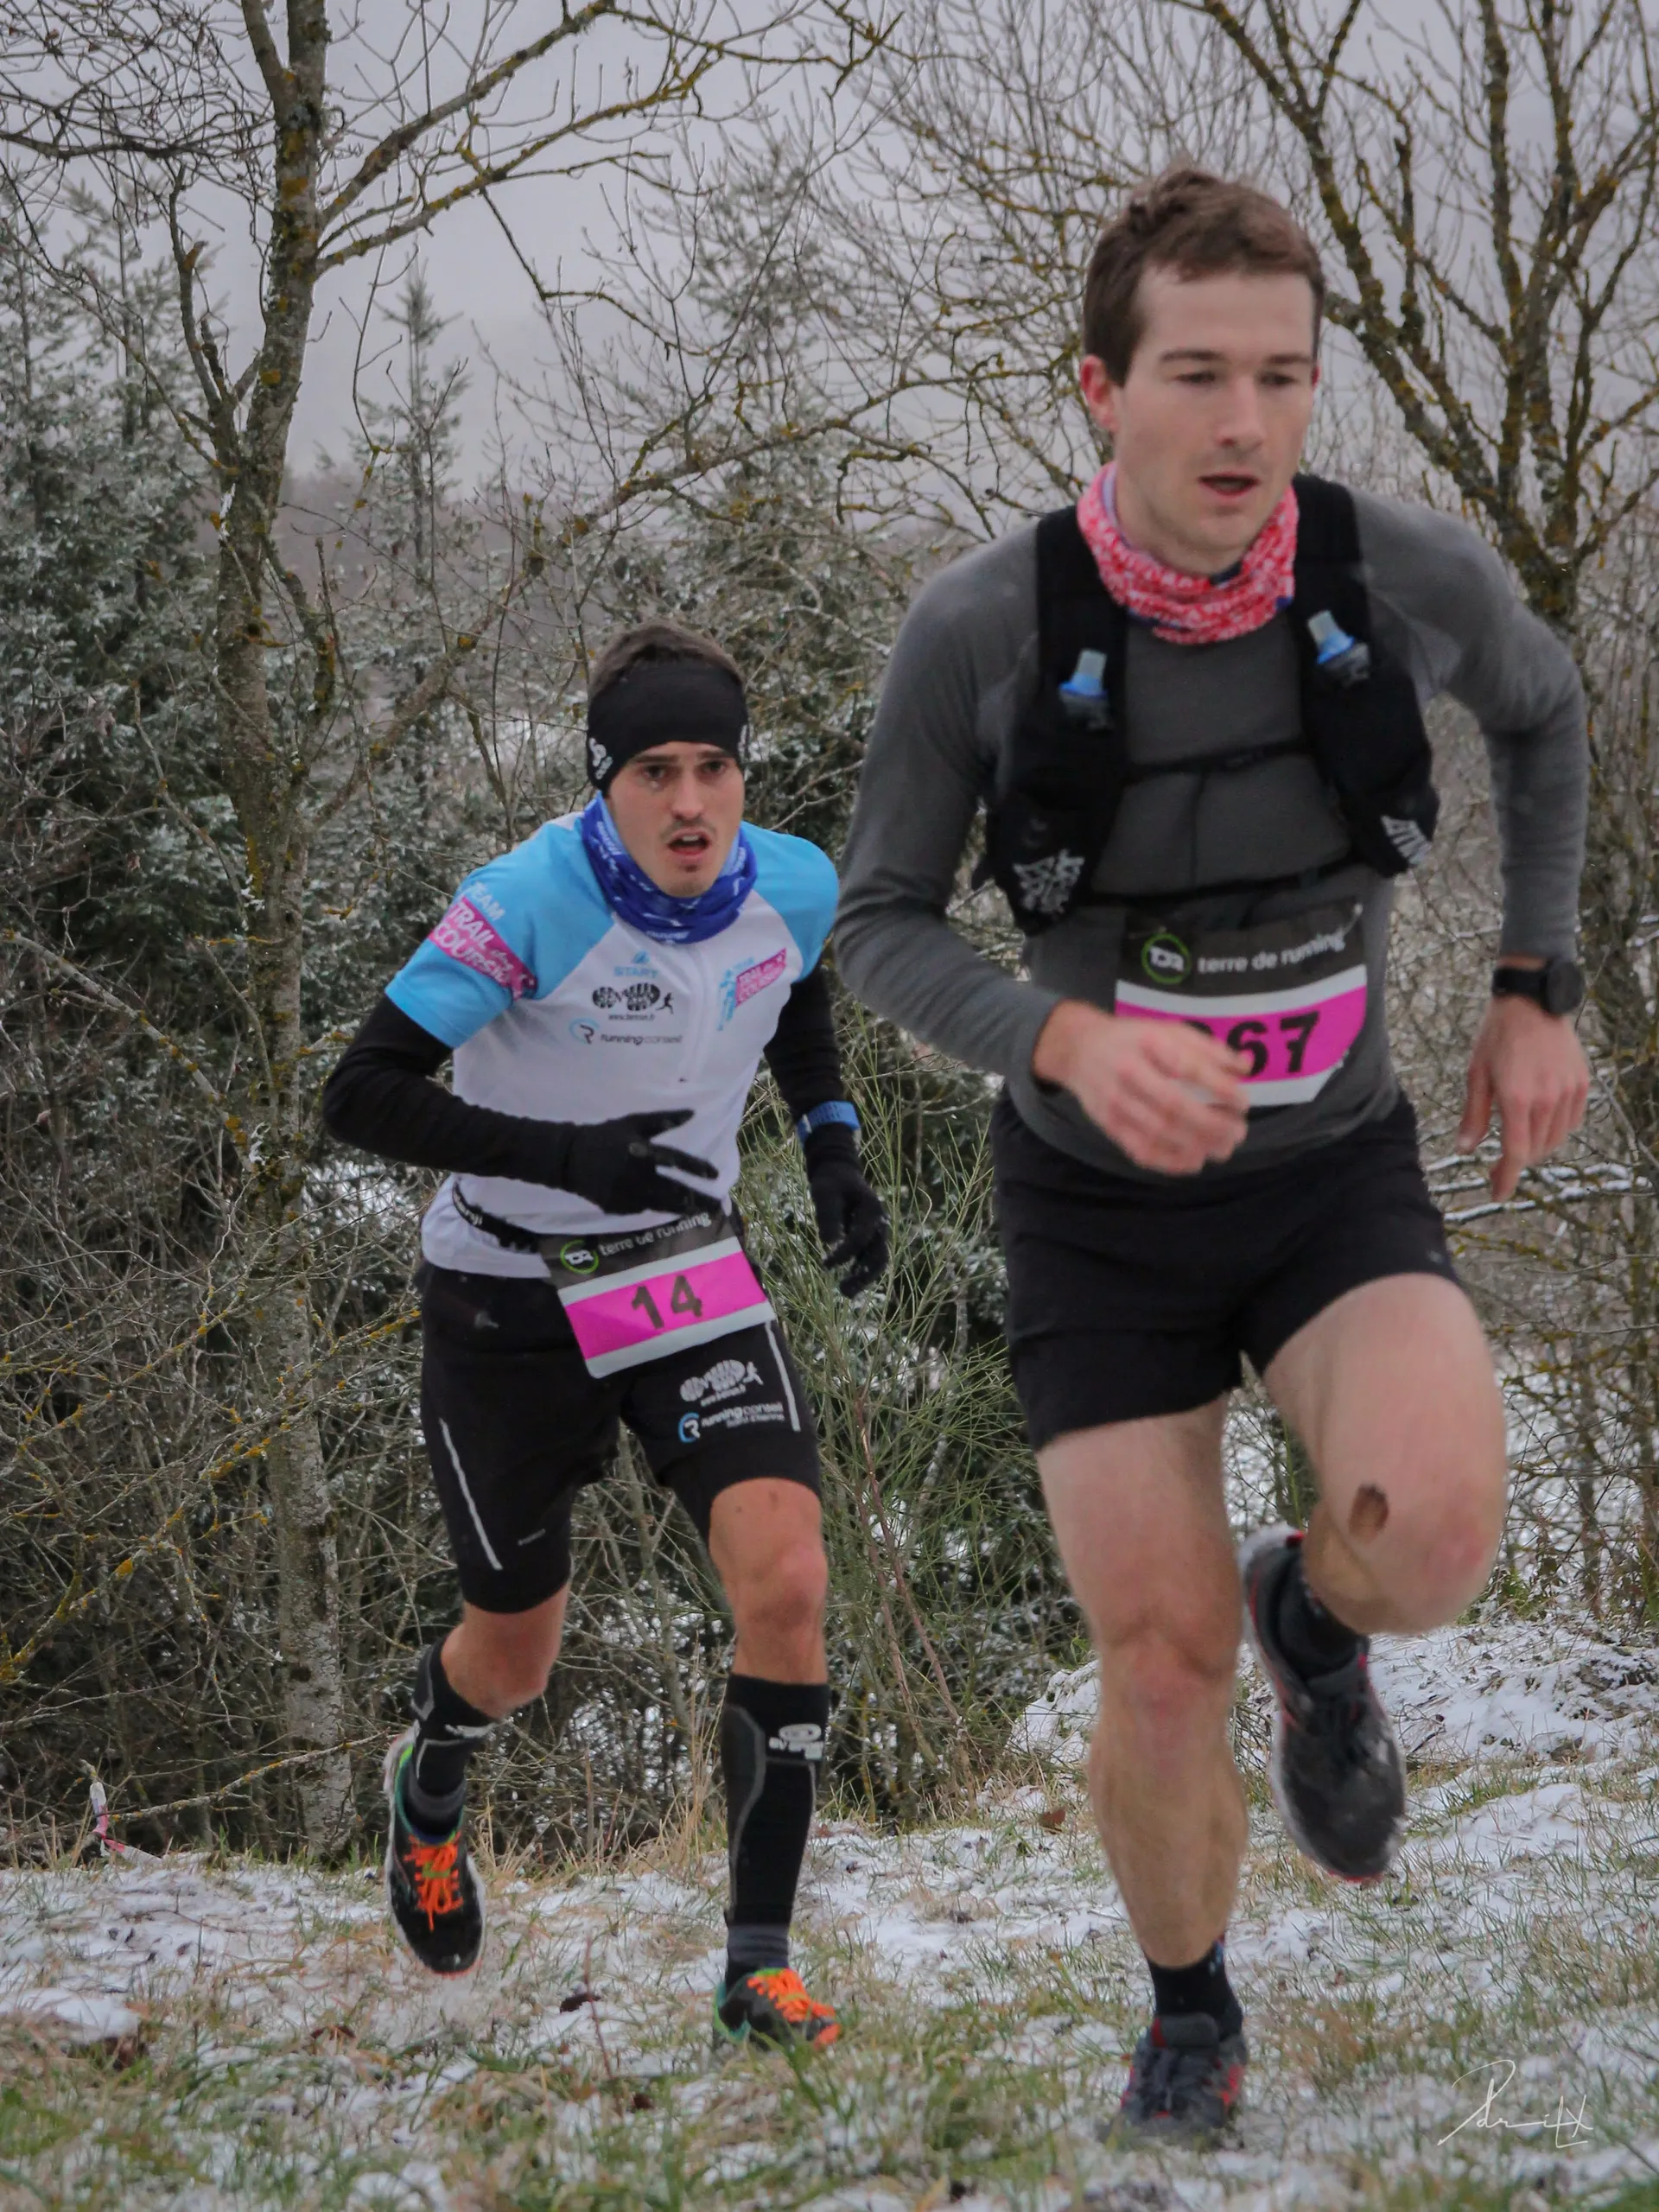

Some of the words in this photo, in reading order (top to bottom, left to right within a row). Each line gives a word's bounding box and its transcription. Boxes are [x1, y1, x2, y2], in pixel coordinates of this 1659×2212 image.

[447, 901, 495, 950] TRAIL
[1197, 957, 1248, 975] terre
[1252, 950, 1277, 970] de
[1281, 931, 1346, 965] running
[598, 1237, 633, 1256] terre
[631, 1274, 703, 1330] 14
